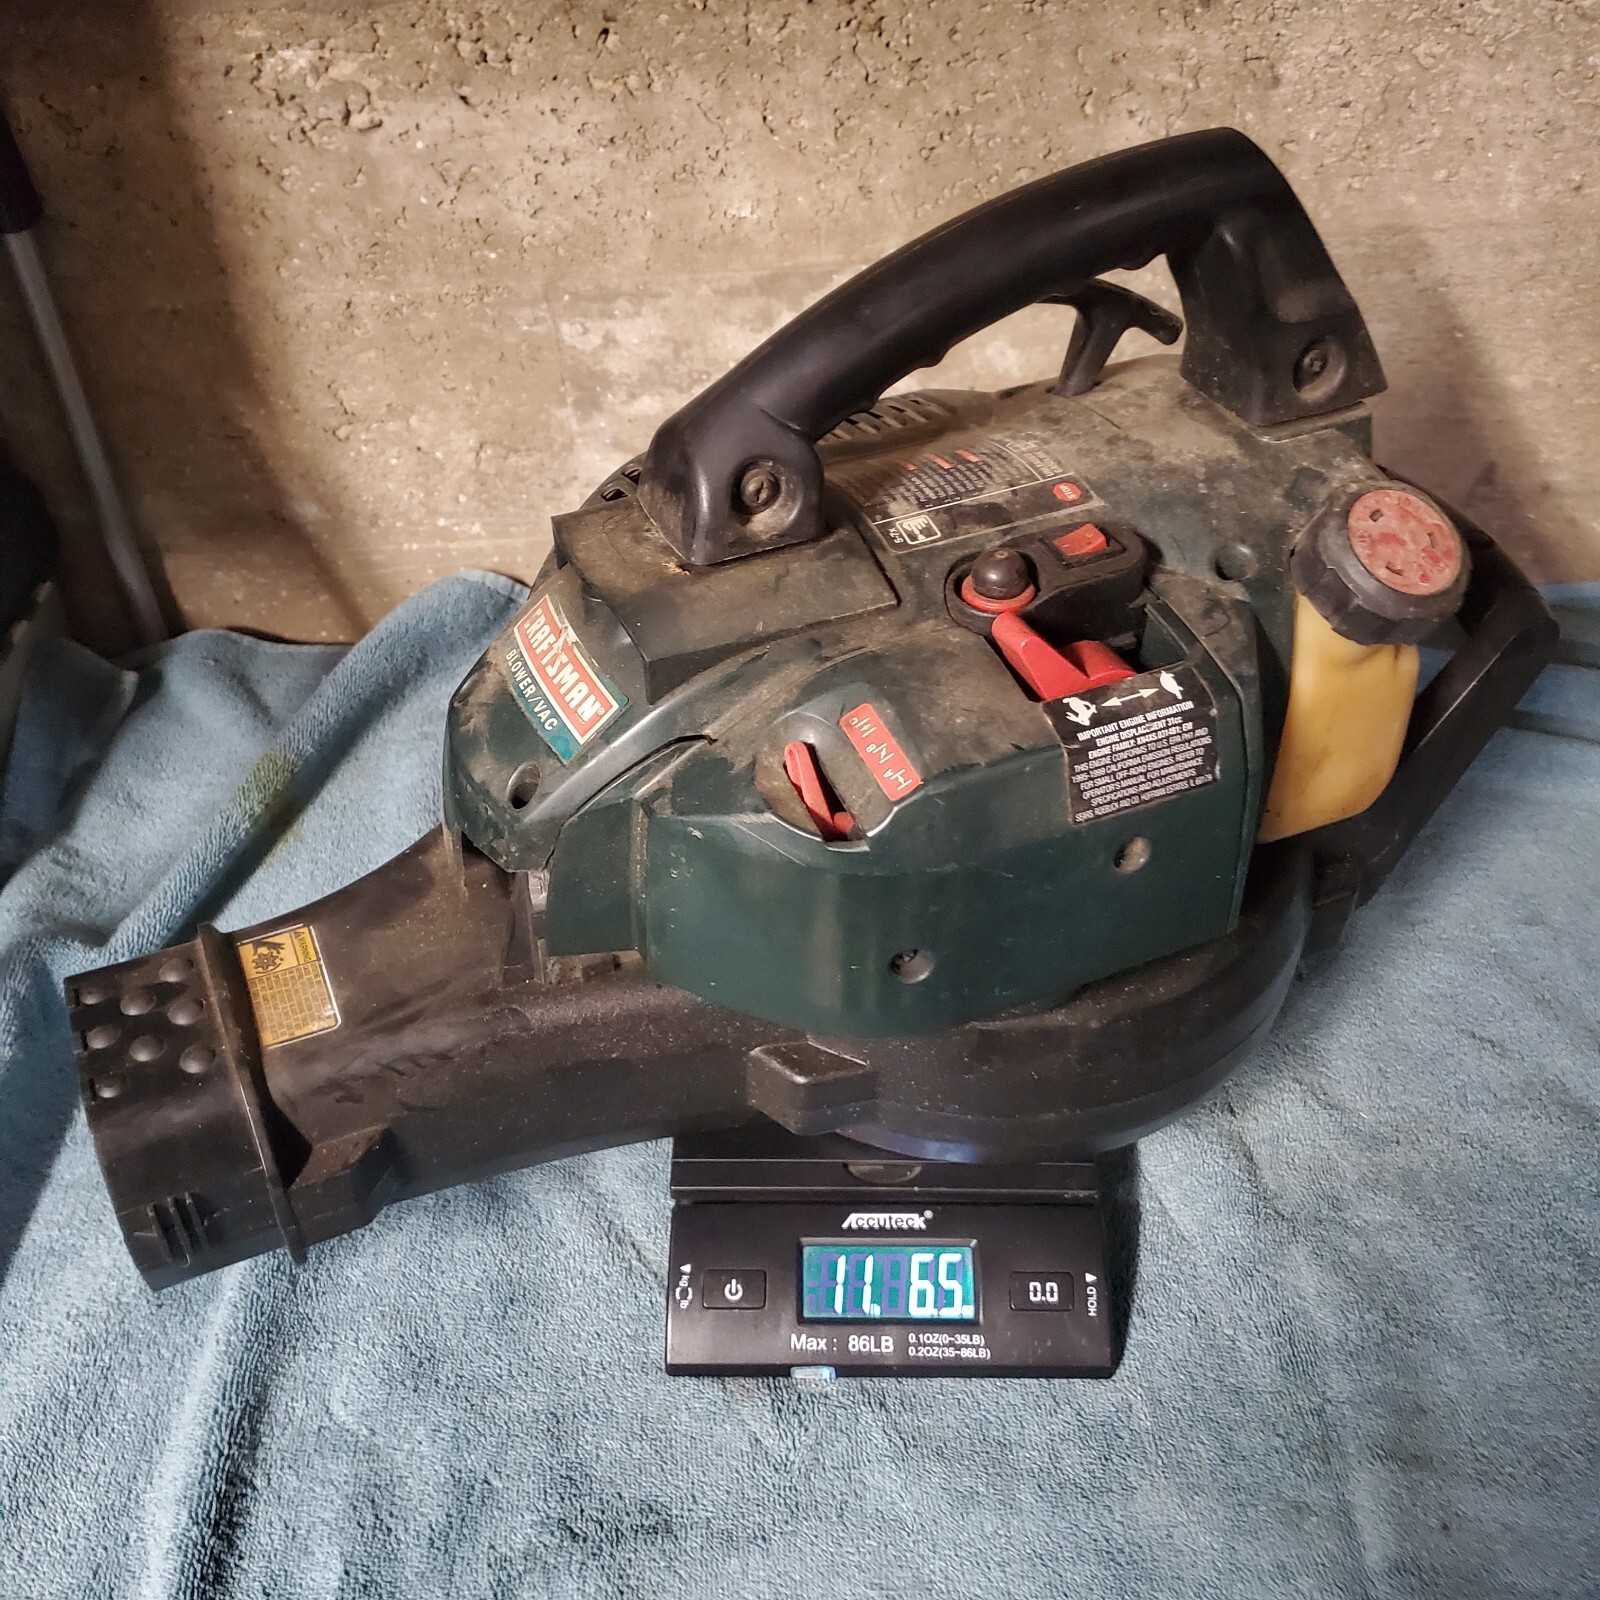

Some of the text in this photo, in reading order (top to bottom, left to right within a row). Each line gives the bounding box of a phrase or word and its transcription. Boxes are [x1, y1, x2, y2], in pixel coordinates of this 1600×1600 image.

[1058, 484, 1076, 500] STOP
[523, 607, 602, 724] CRAFTSMAN
[505, 648, 558, 731] BLOWER/VAC
[1076, 700, 1194, 741] IMPORTANT ENGINE INFORMATION
[1073, 762, 1089, 773] THIS
[1089, 755, 1112, 769] ENGINE
[1112, 745, 1147, 762] CONFORMS
[1147, 742, 1156, 751] TO
[1194, 727, 1209, 737] AND
[1088, 746, 1112, 760] ENGINE
[1096, 733, 1120, 747] ENGINE
[1105, 756, 1142, 774] CALIFORNIA
[1141, 748, 1171, 763] EMISSION
[1170, 735, 1212, 753] REGULATIONS
[1080, 780, 1094, 790] FOR
[1093, 774, 1116, 787] SMALL
[1116, 764, 1147, 780] OFF-ROAD
[1175, 749, 1196, 761] REFER
[1195, 747, 1205, 756] TO
[1120, 774, 1147, 788] MANUAL
[1146, 770, 1160, 779] FOR
[1160, 756, 1205, 776] MAINTENANCE
[1090, 785, 1139, 807] SPECIFICATIONS
[1138, 781, 1152, 791] AND
[1028, 1281, 1059, 1303] 0.0
[1086, 1286, 1098, 1316] HOLD
[848, 1335, 894, 1353] 86LB
